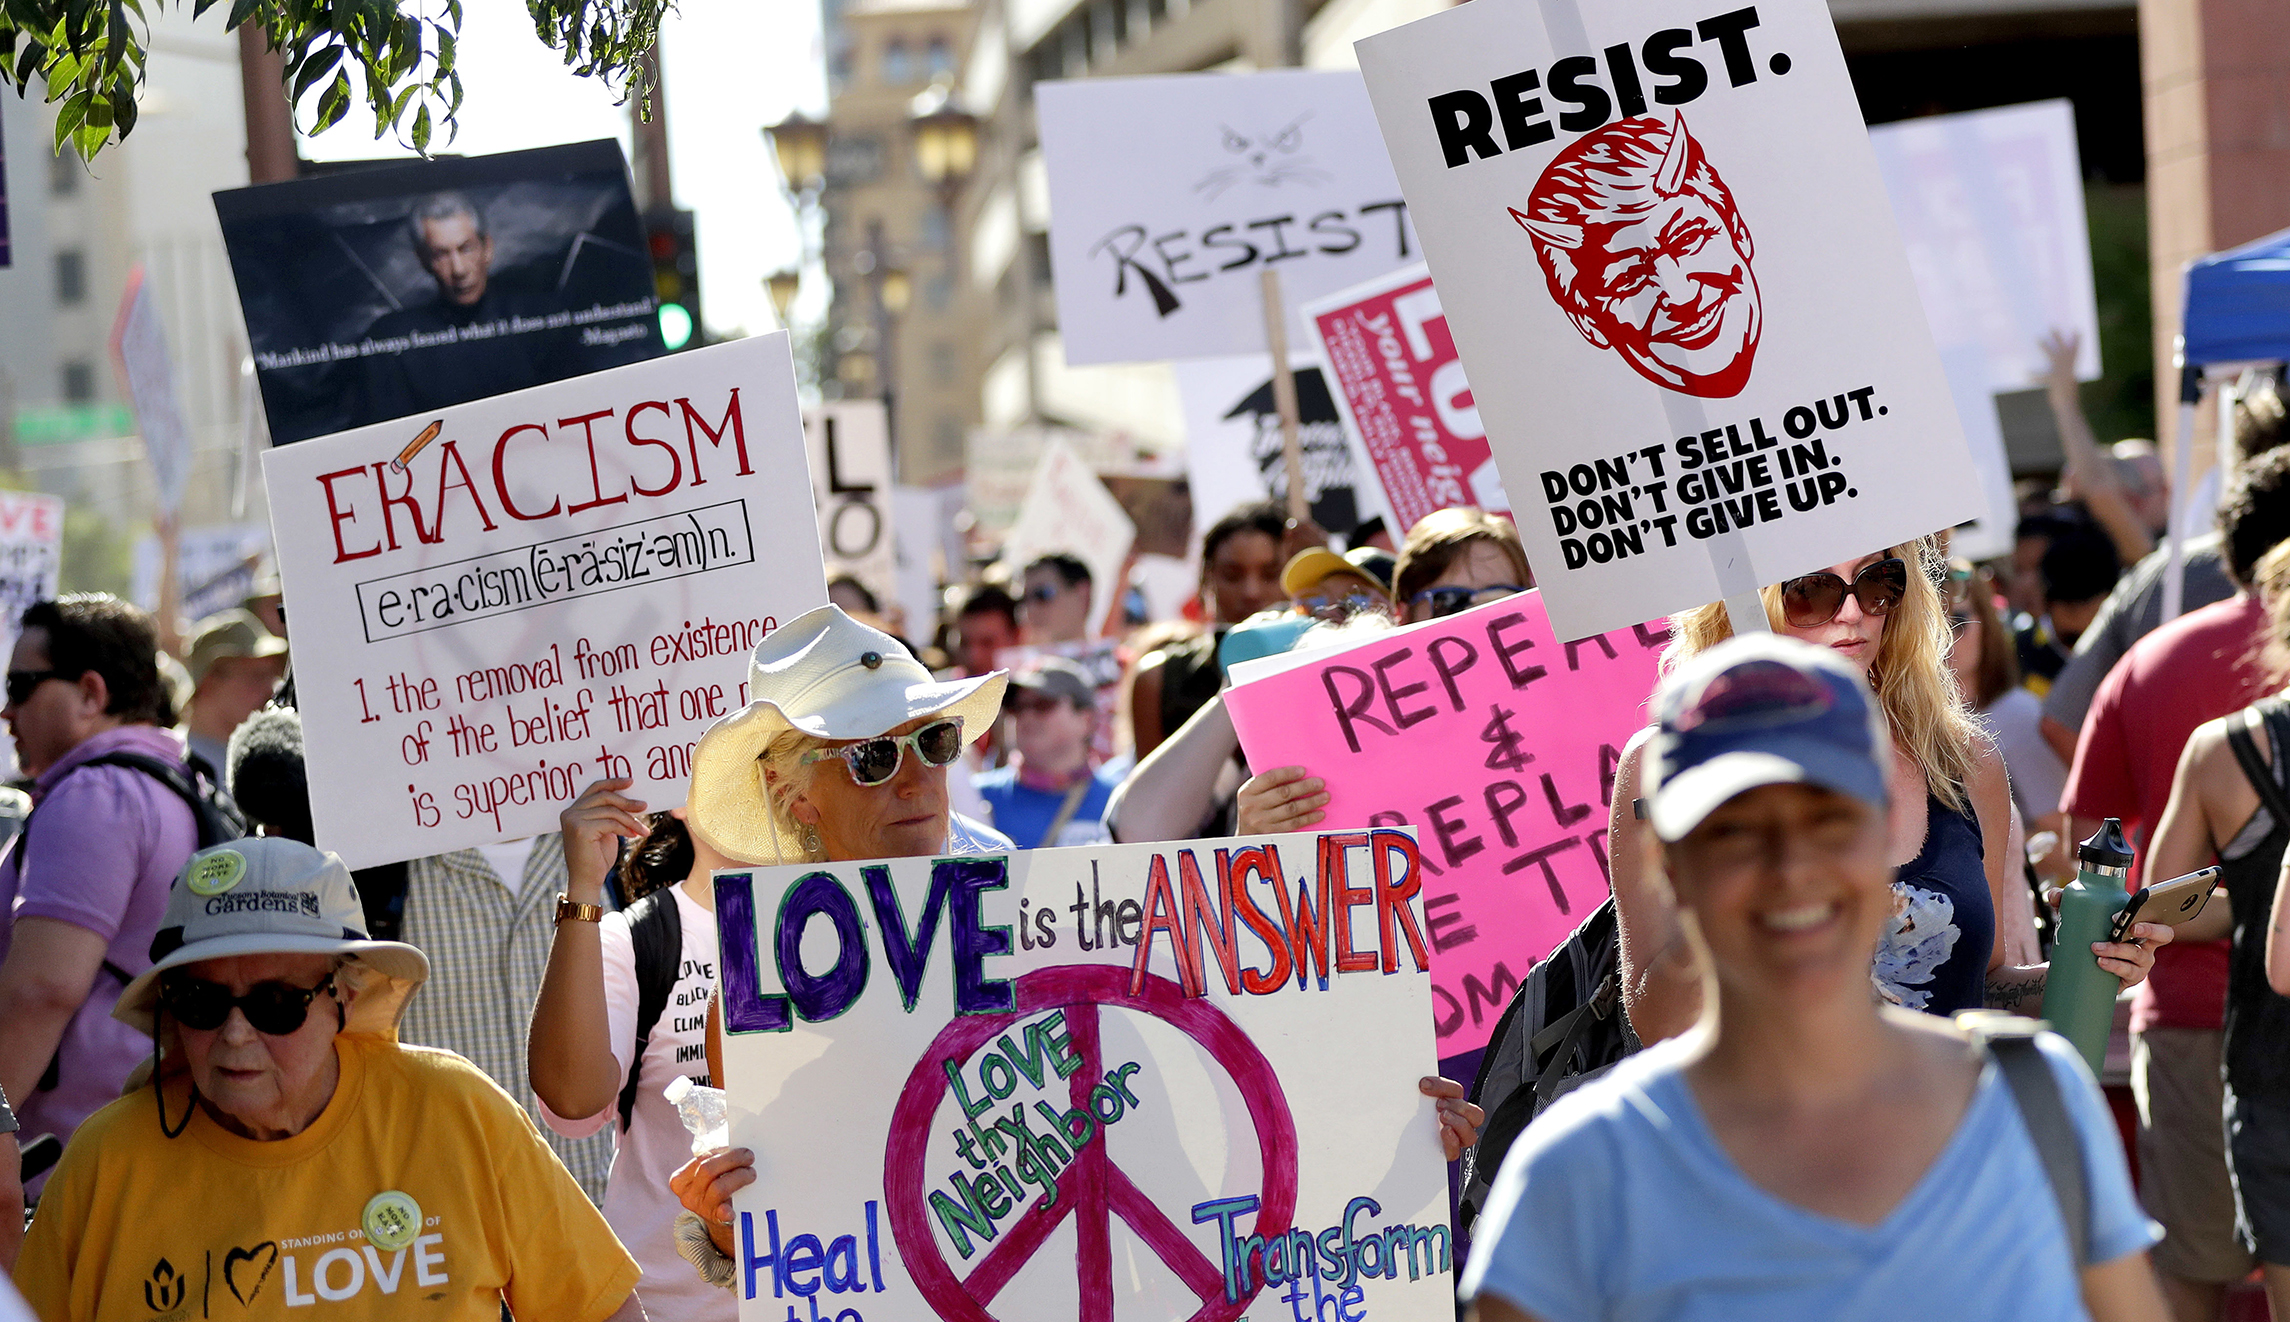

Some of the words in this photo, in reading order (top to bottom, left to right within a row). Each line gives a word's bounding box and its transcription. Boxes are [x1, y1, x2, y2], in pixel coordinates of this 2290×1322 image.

[1428, 5, 1792, 169] RESIST.
[1088, 199, 1408, 319] RESIST
[330, 341, 358, 360] has
[359, 336, 411, 356] always
[410, 329, 458, 349] feared
[458, 320, 497, 341] what
[496, 317, 509, 336] it
[510, 314, 545, 334] does
[545, 309, 571, 329] not
[1354, 308, 1424, 407] your
[1409, 416, 1467, 507] neig
[1393, 286, 1511, 513] LO
[1540, 443, 1666, 504] DON'T
[1675, 417, 1779, 470] SELL
[1783, 385, 1889, 440] OUT.
[316, 388, 755, 565] ERACISM
[1550, 481, 1668, 537] DON'T
[1676, 454, 1773, 506] GIVE
[1776, 438, 1842, 480] IN.
[1560, 514, 1678, 570] DON'T
[1685, 488, 1783, 540] GIVE
[1786, 471, 1859, 513] UP.
[354, 678, 382, 724] 1.
[386, 673, 441, 714] the
[456, 643, 564, 703] removal
[574, 638, 640, 680] from
[650, 615, 778, 667] existence
[402, 720, 433, 766] of
[447, 714, 498, 758] the
[507, 688, 594, 748] belief
[608, 679, 669, 733] that
[680, 684, 727, 721] one
[1480, 703, 1536, 773] &
[408, 784, 442, 828] is
[454, 759, 582, 833] superior
[596, 745, 632, 779] to
[205, 893, 299, 916] Gardens
[221, 891, 253, 900] Tucson
[260, 890, 299, 900] Botanical
[714, 855, 1017, 1035] LOVE
[1019, 898, 1058, 951] is
[1070, 859, 1142, 951] the
[1127, 829, 1429, 998] ANSWER
[676, 1043, 706, 1064] IMMI
[942, 1009, 1085, 1121] LOVE
[928, 1061, 1142, 1260] Neighbor
[952, 1102, 1026, 1169] thy
[281, 1231, 345, 1250] STANDING
[348, 1229, 368, 1240] ON
[425, 1216, 441, 1227] OF
[398, 1205, 410, 1220] NO
[741, 1200, 886, 1300] Heal
[1191, 1194, 1453, 1305] Transform
[283, 1233, 449, 1307] LOVE
[1281, 1262, 1368, 1322] the
